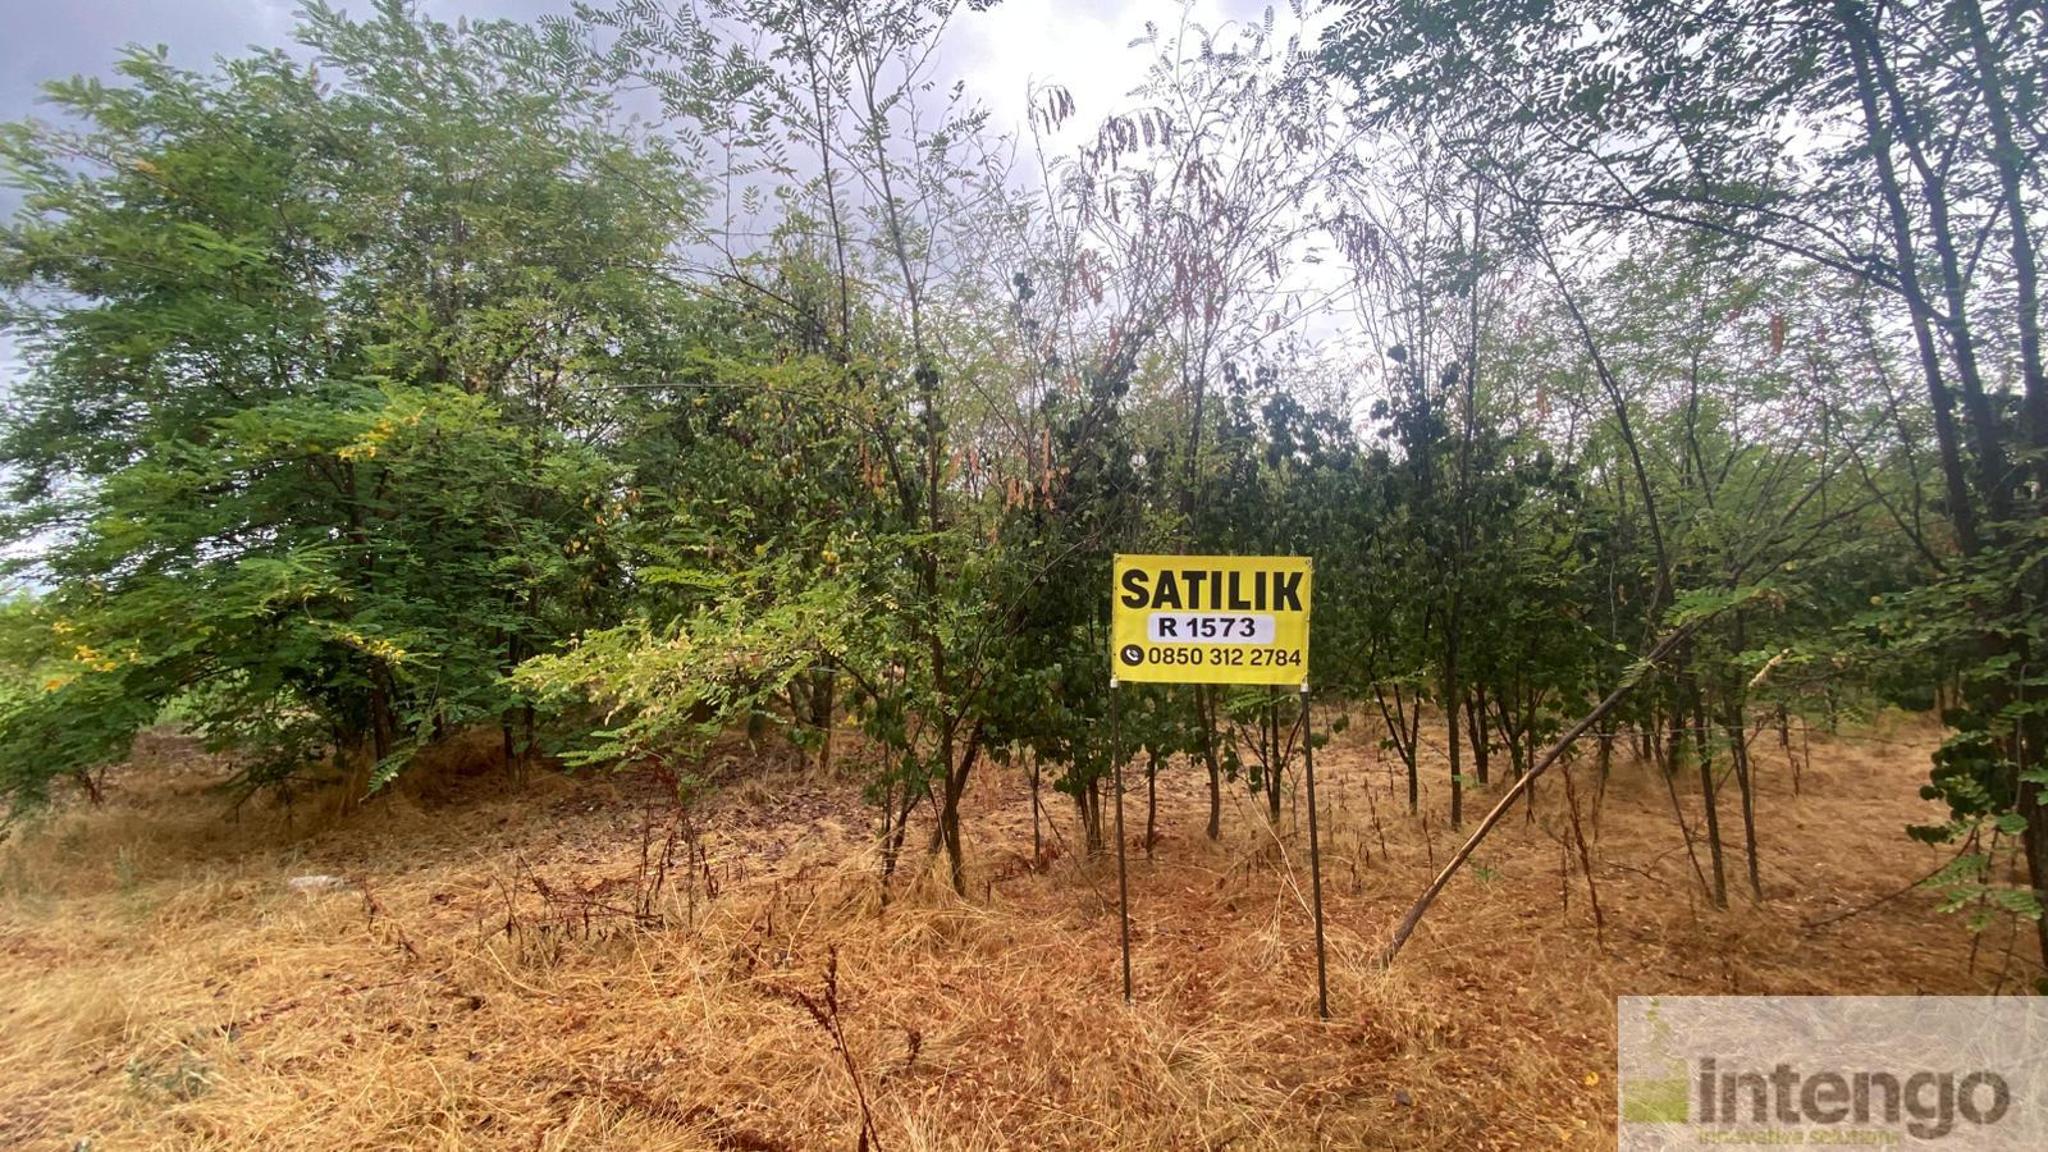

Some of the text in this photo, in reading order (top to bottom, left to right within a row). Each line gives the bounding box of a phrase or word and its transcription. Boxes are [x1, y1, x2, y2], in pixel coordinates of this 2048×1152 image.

[1121, 568, 1304, 611] SATILIK
[1158, 617, 1256, 638] R 1573
[1148, 647, 1301, 667] 0850 312 2784
